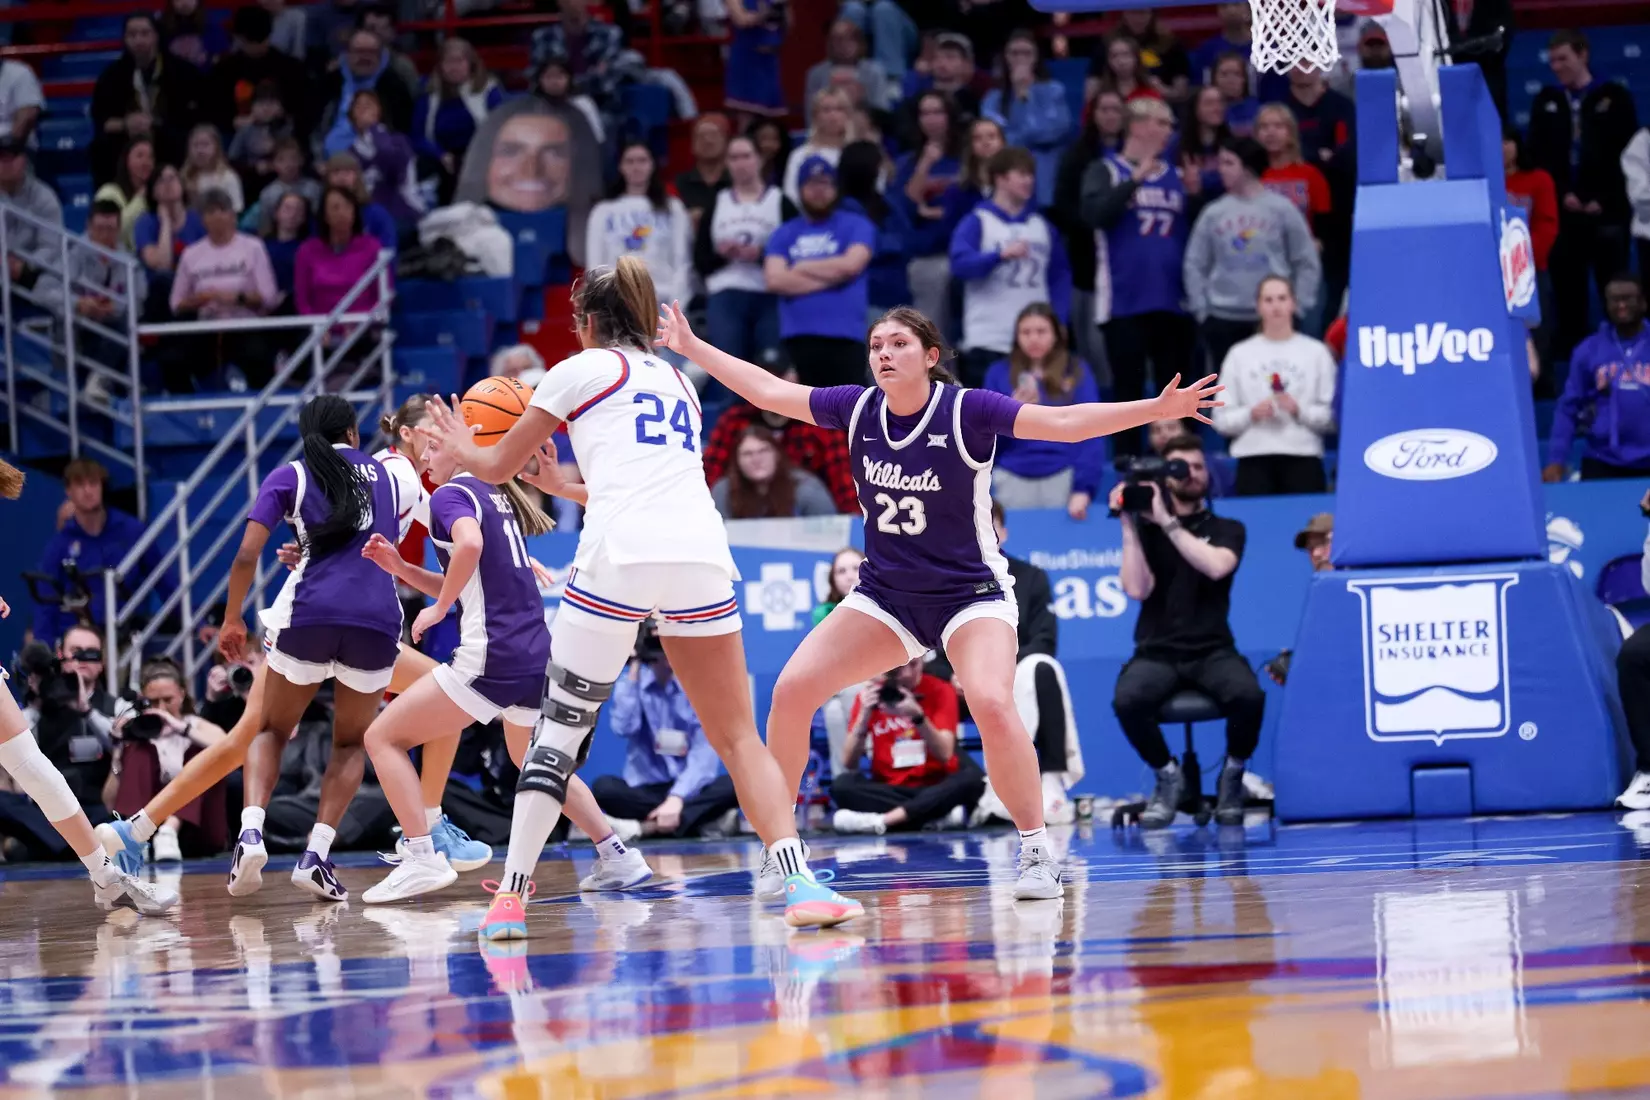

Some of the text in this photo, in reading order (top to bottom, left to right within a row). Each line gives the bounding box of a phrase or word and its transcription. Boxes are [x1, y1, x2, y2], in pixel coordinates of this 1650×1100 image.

[1137, 210, 1175, 236] 77
[1358, 322, 1494, 375] HyVee
[633, 393, 695, 453] 24
[862, 455, 942, 491] Wildcats
[1392, 439, 1468, 469] Ford
[874, 492, 927, 536] 23
[503, 519, 531, 568] 11
[1047, 575, 1128, 620] as
[1379, 620, 1490, 643] SHELTER
[1379, 643, 1490, 661] INSURANCE
